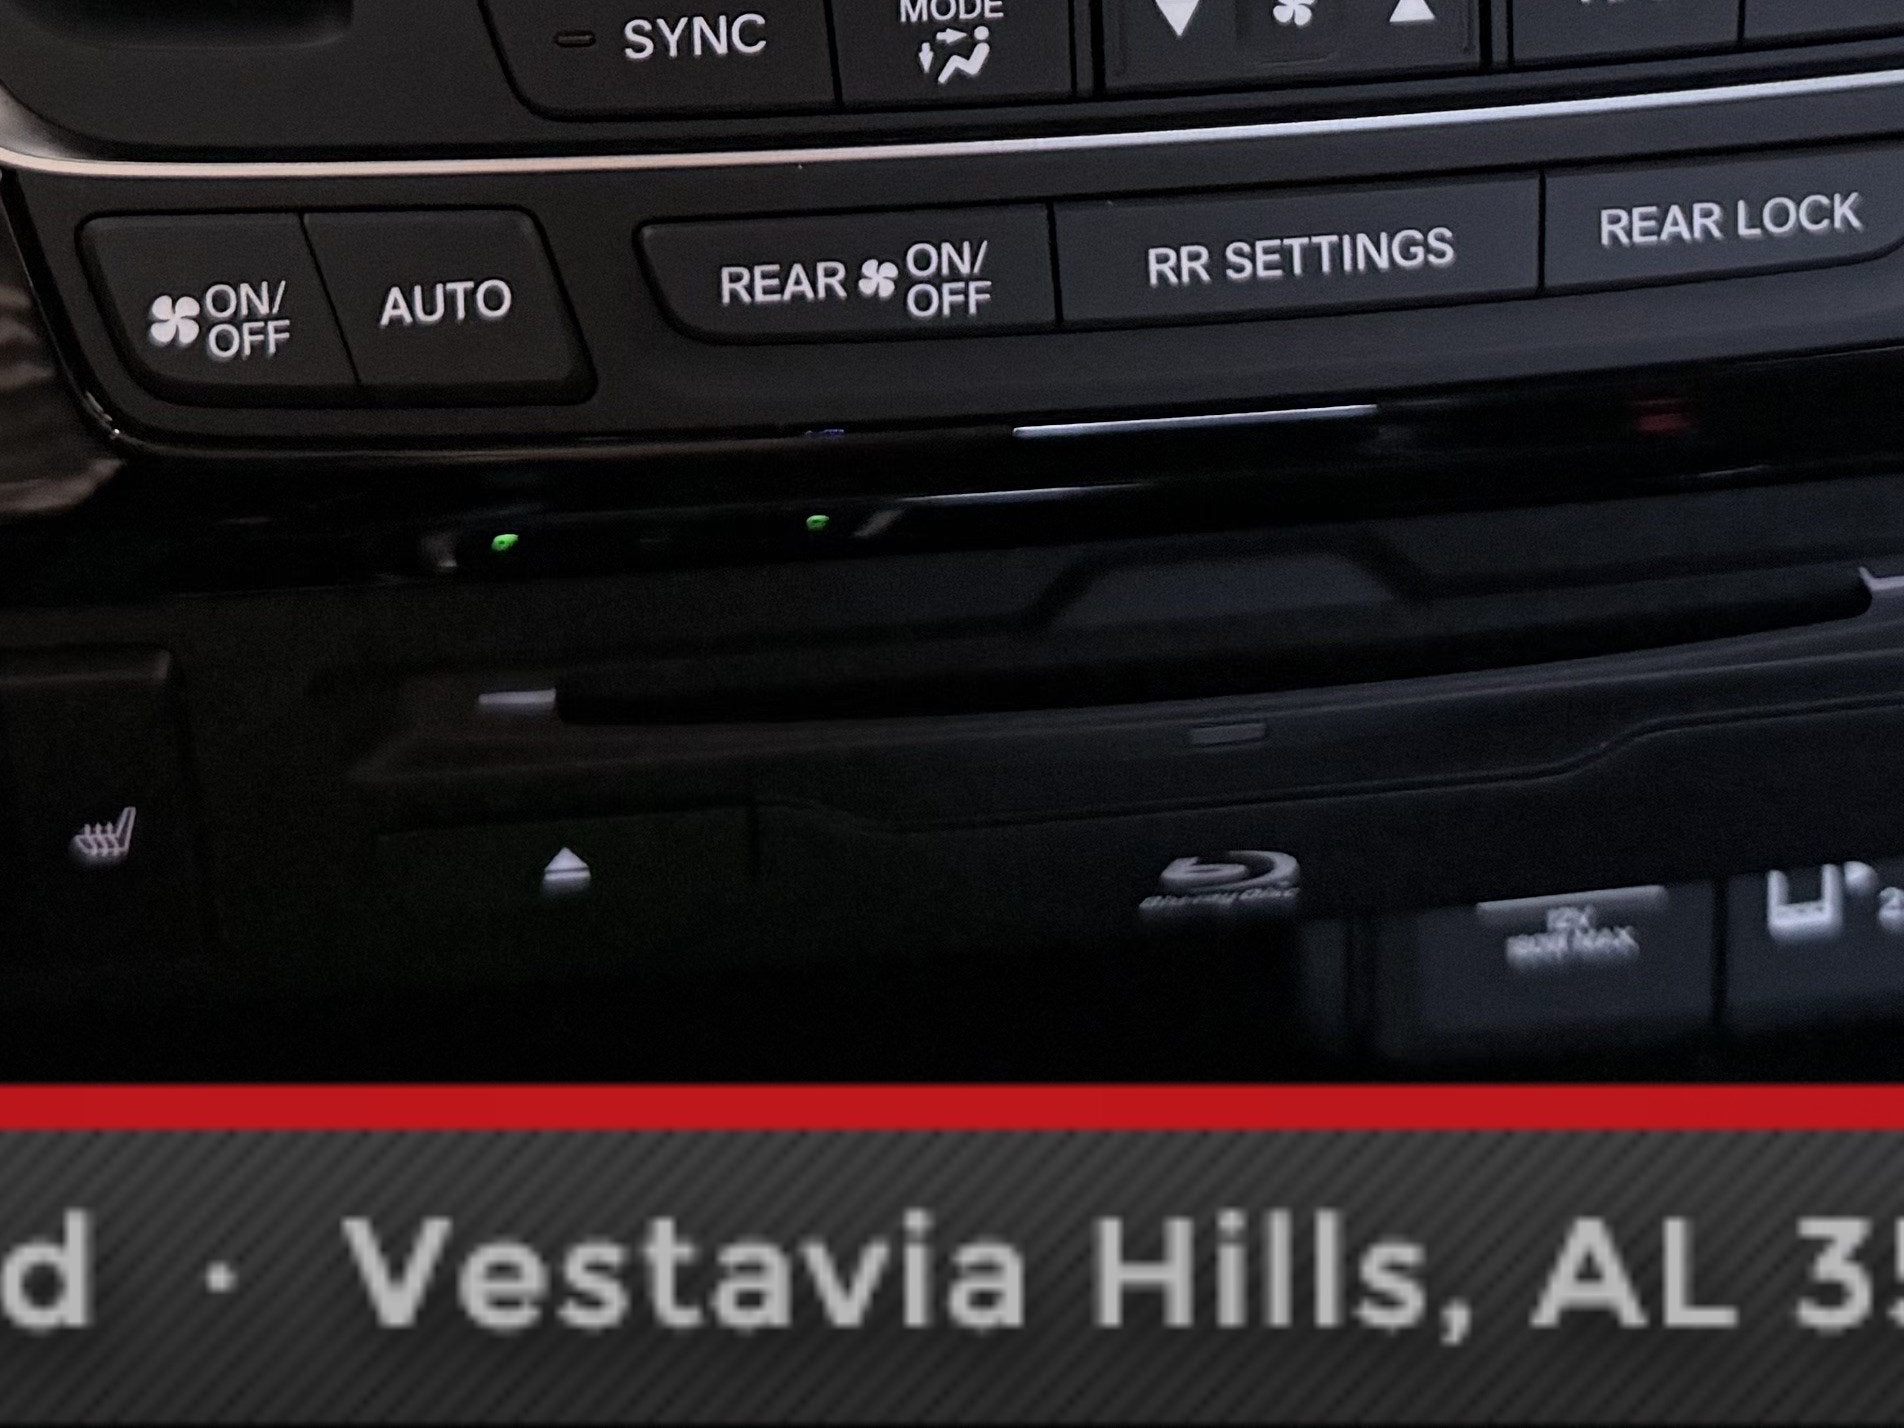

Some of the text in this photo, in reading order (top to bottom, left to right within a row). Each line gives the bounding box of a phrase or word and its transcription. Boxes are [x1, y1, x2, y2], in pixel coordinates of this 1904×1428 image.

[624, 13, 767, 61] SYNC
[1600, 191, 1865, 250] REAR LOCK
[721, 240, 989, 305] REAR ON/
[1147, 226, 1457, 290] RR SETTINGS
[204, 280, 291, 321] ON/
[379, 279, 512, 327] AUTO
[906, 280, 992, 319] OFF
[206, 319, 291, 361] OFF
